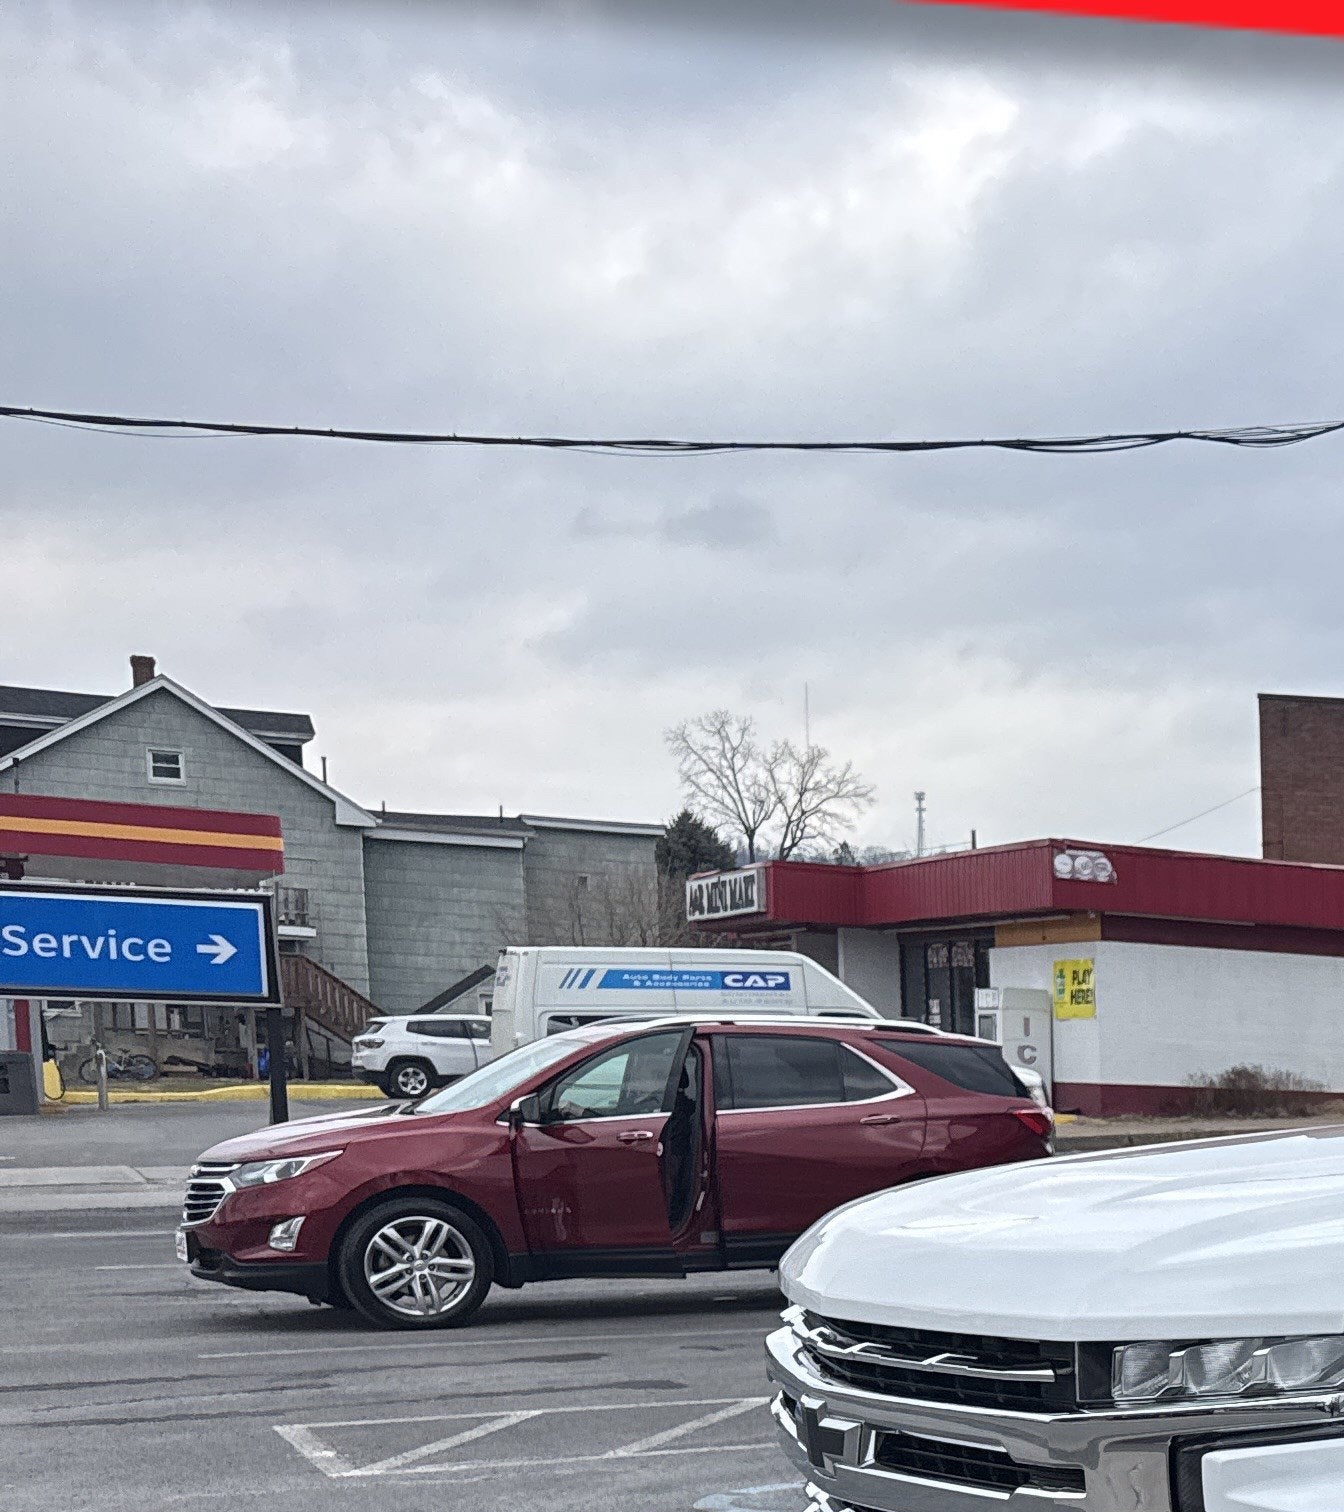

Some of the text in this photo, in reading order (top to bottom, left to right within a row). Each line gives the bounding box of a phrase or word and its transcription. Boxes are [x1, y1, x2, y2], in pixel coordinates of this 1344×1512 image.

[1, 924, 172, 963] Service
[723, 974, 786, 988] CAP
[1072, 968, 1092, 986] PLAY
